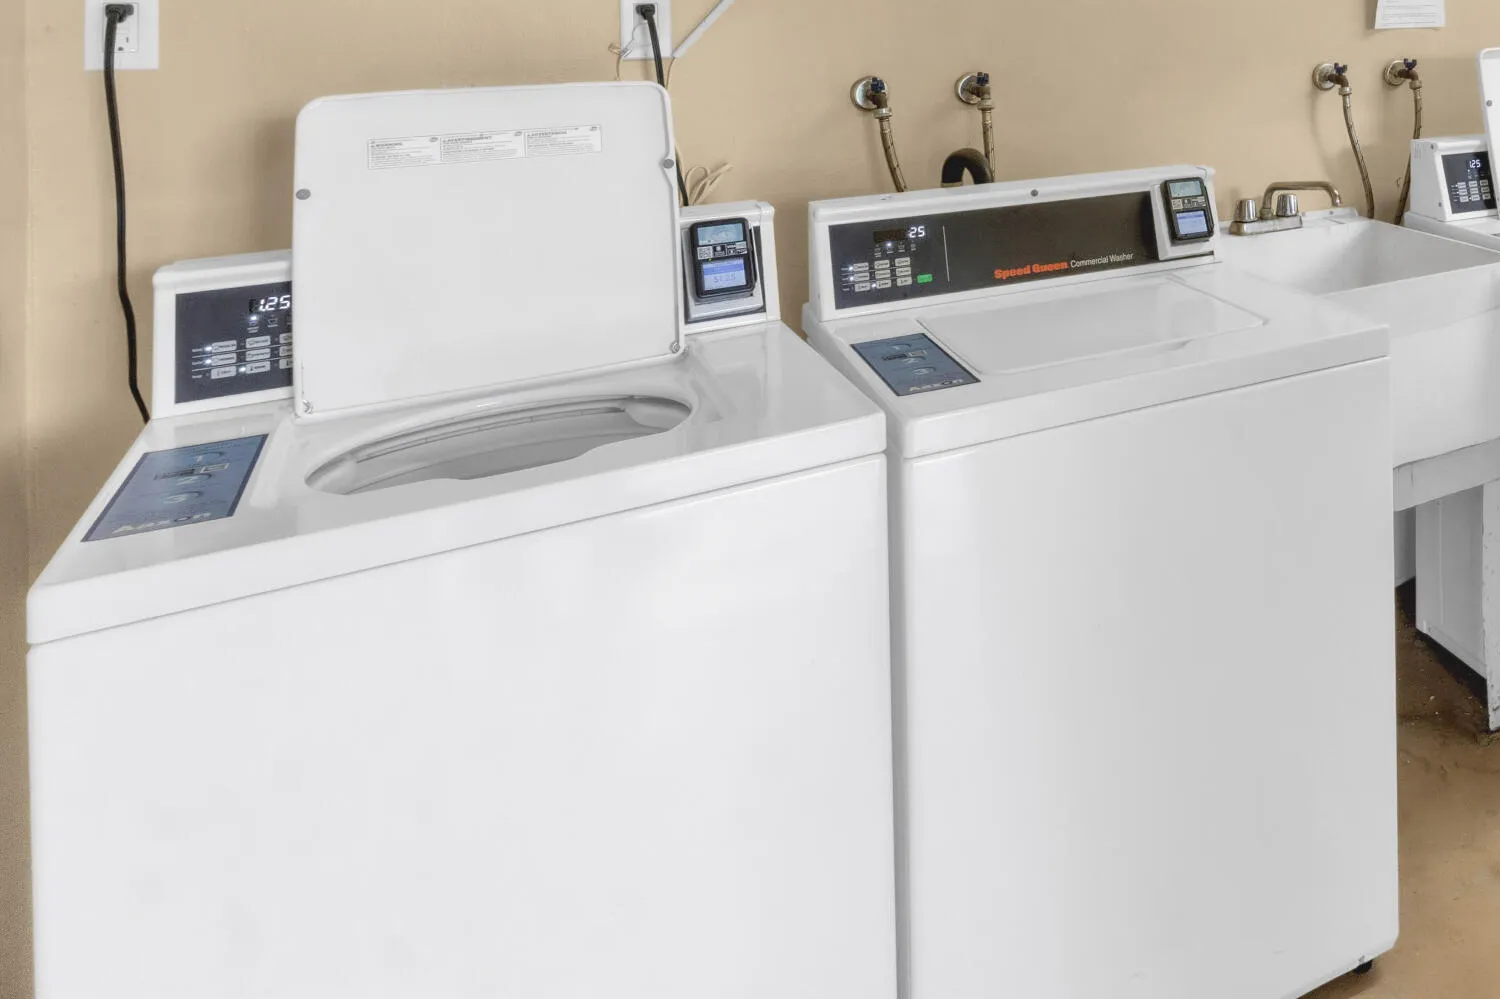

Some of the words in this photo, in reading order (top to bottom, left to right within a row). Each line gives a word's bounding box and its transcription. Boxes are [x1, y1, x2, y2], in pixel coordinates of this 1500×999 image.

[994, 265, 1031, 280] Speed
[1032, 261, 1068, 273] Queen
[1070, 257, 1109, 268] Commercial
[1109, 253, 1133, 263] Washer
